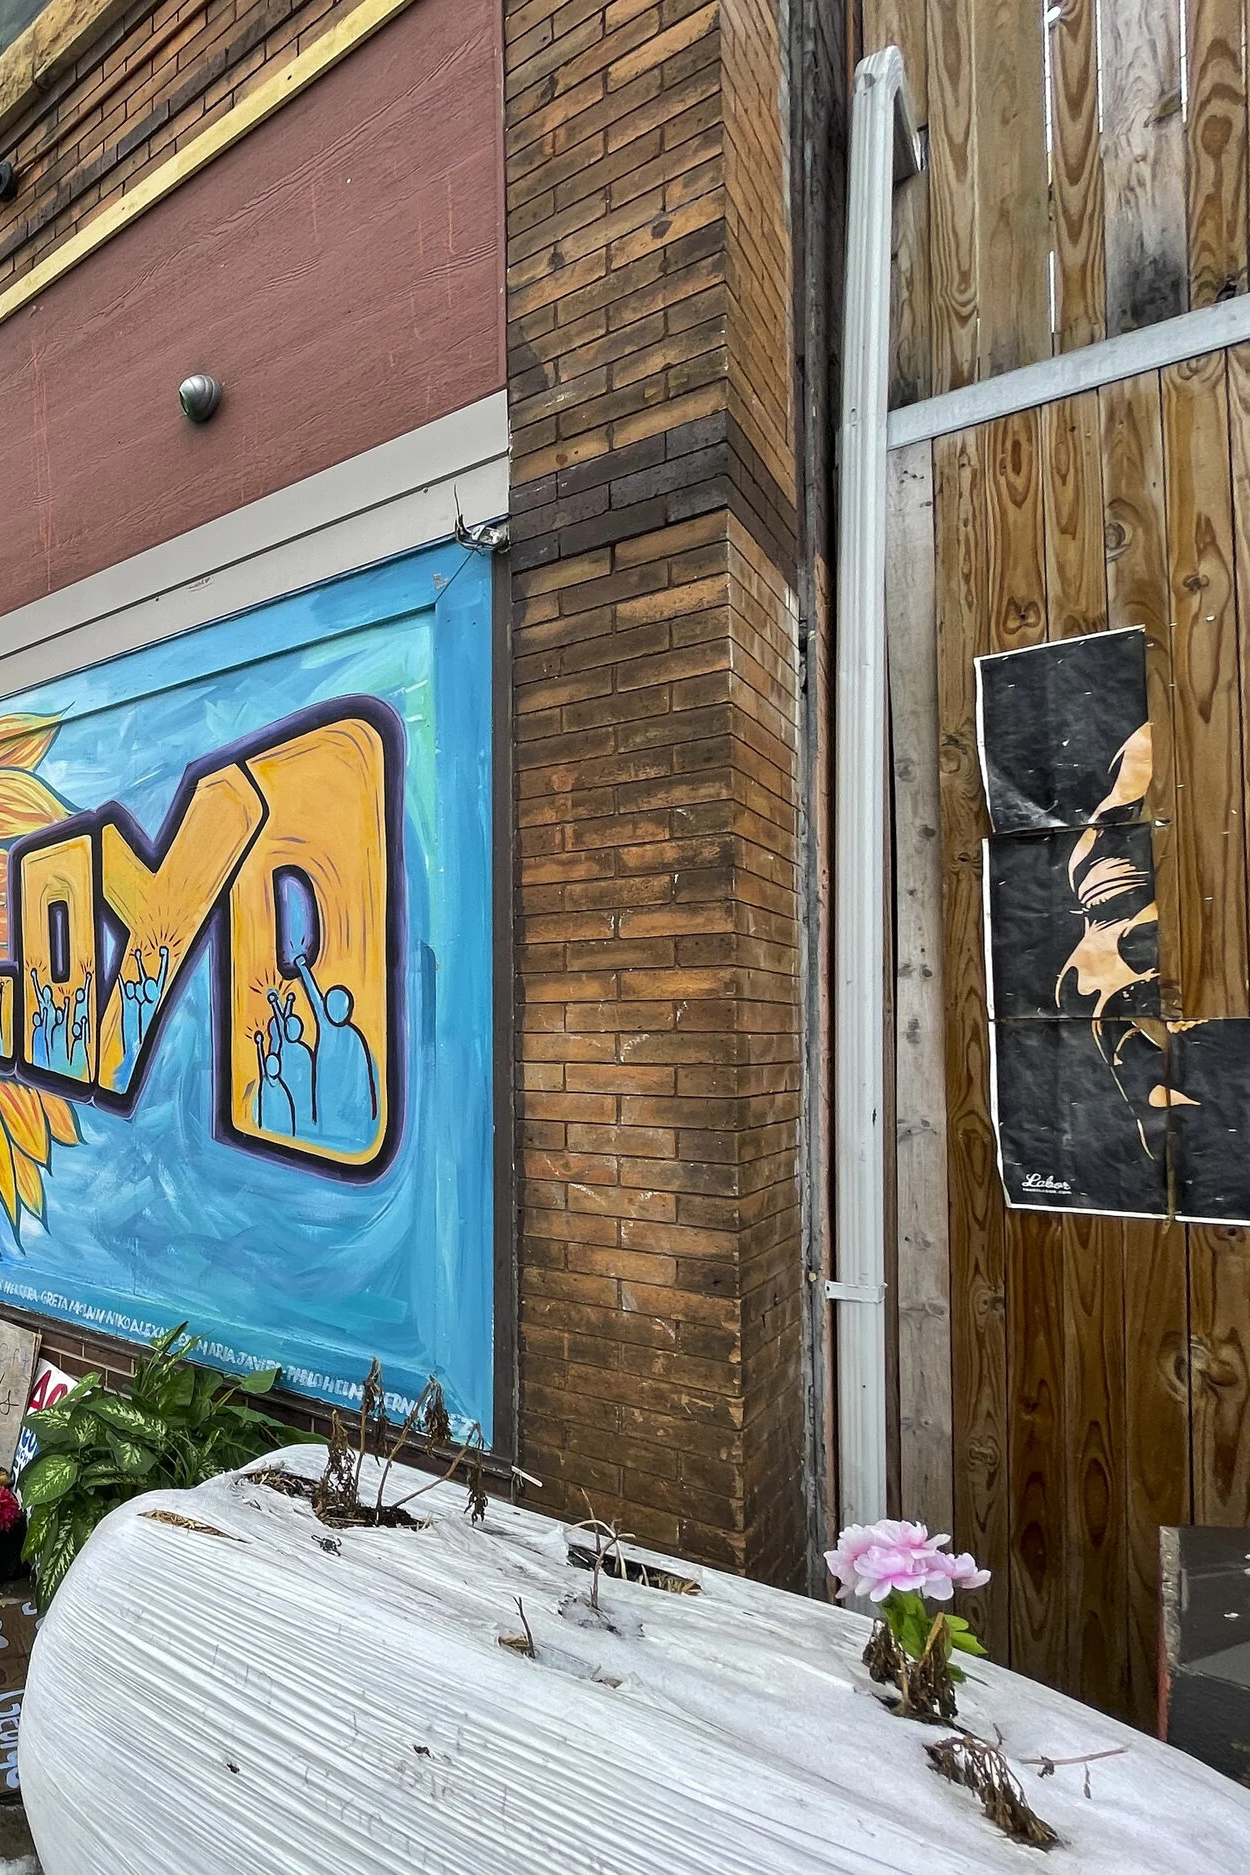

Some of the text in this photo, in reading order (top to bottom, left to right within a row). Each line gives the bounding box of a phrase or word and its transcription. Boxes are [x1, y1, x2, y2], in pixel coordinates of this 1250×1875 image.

[1022, 1173, 1071, 1190] Labor
[40, 1290, 68, 1310] GRETA
[105, 1310, 131, 1329] NIKO
[196, 1339, 237, 1364] MARIA
